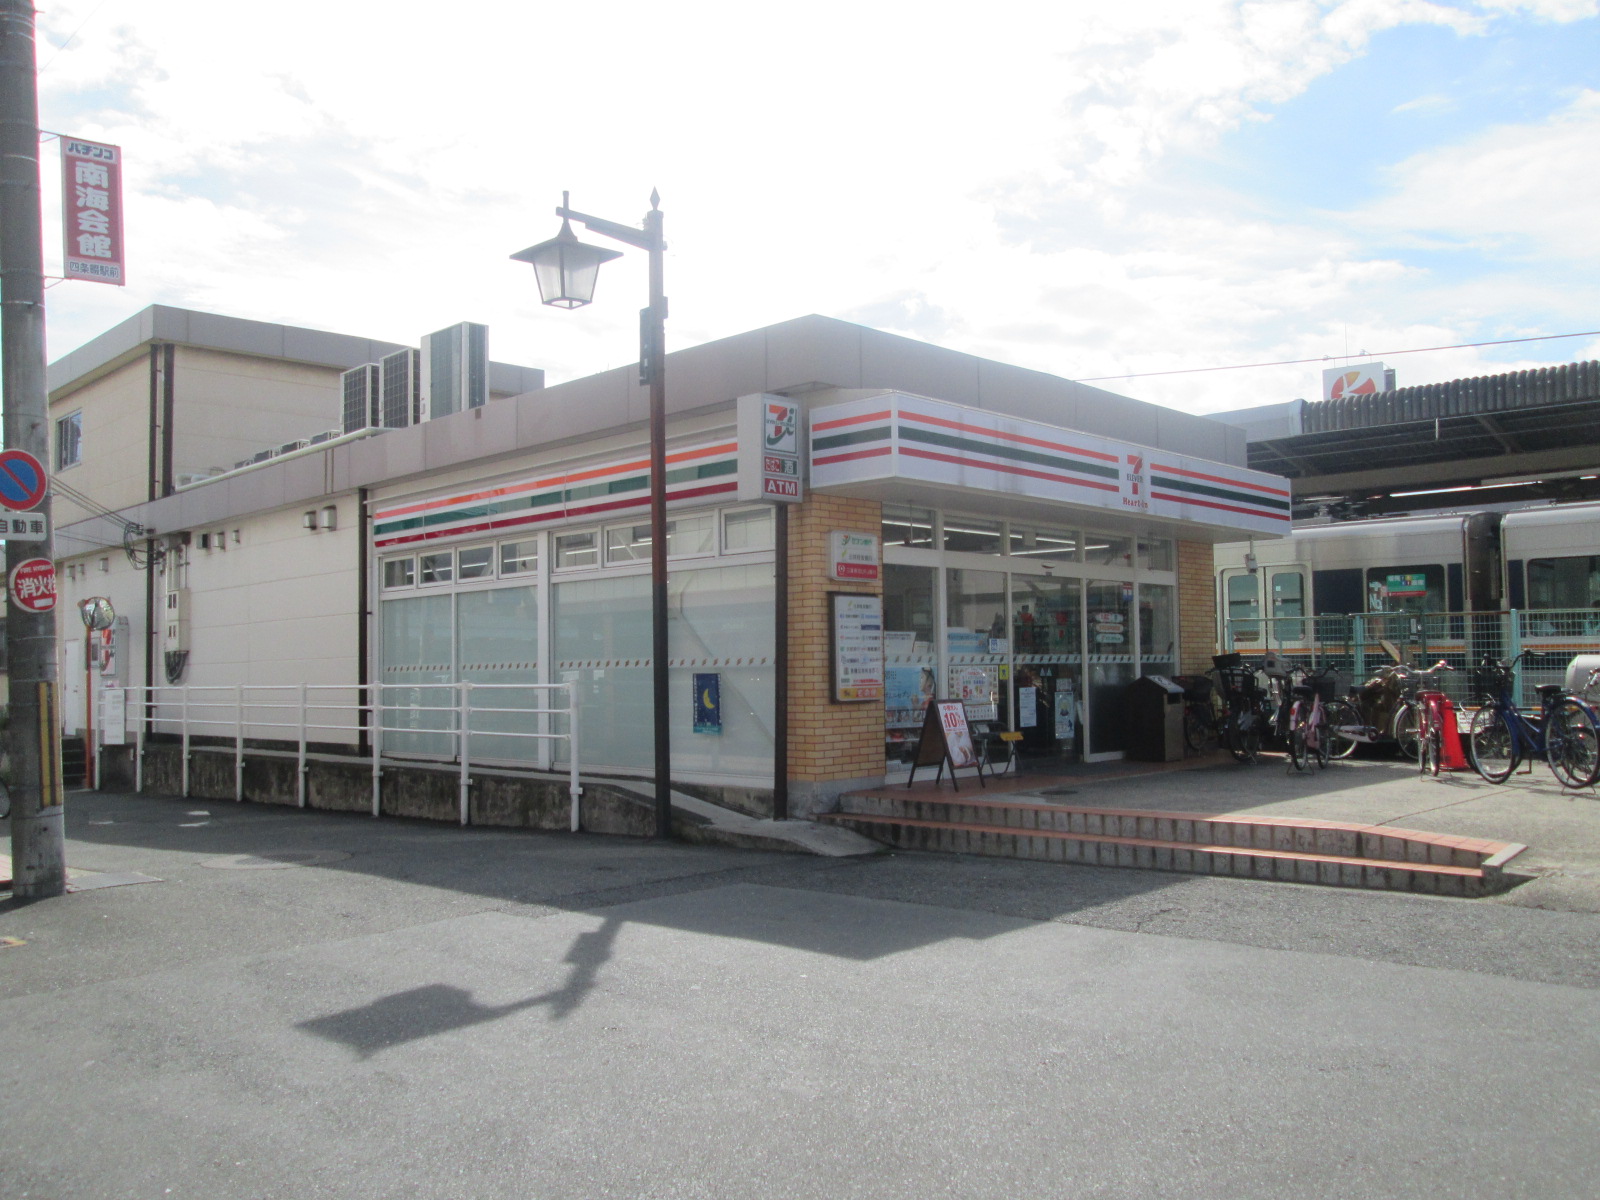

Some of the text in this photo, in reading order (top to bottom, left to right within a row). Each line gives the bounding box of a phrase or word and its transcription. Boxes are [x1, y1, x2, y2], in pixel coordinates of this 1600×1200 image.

[68, 142, 113, 160] パチンコ
[75, 161, 111, 258] 南海会館
[765, 458, 794, 474] たばこ 酒
[767, 479, 796, 495] ATM
